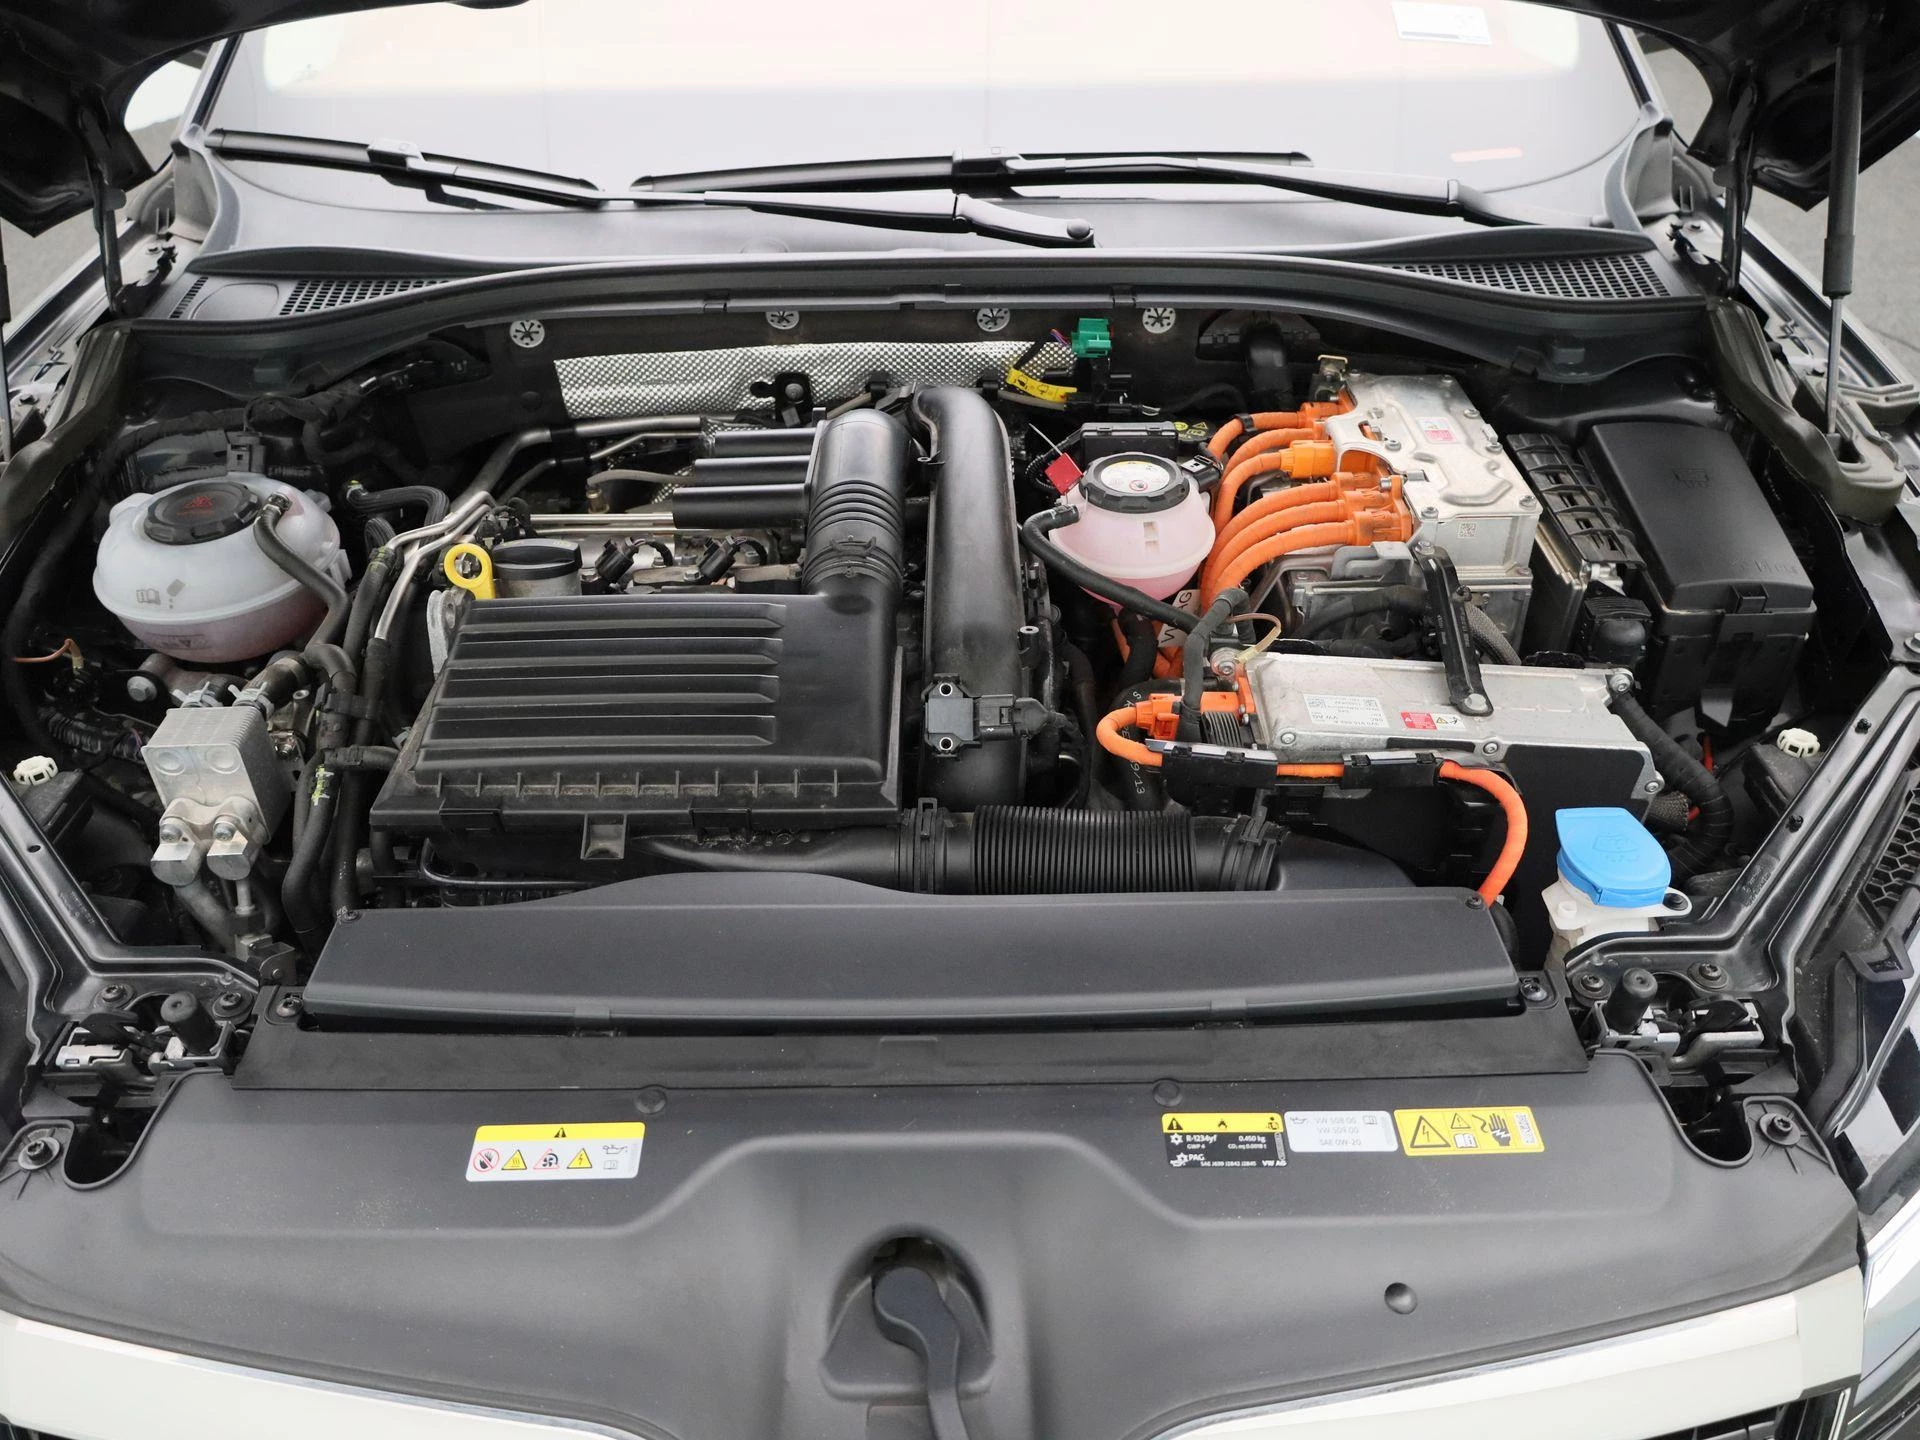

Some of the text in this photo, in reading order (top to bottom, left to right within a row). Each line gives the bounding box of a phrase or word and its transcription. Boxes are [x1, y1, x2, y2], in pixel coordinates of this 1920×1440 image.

[1185, 1134, 1217, 1144] R-1234yf
[1257, 1135, 1267, 1144] kg
[1320, 1138, 1361, 1146] SAE 0W-20
[1188, 1153, 1206, 1161] PAG
